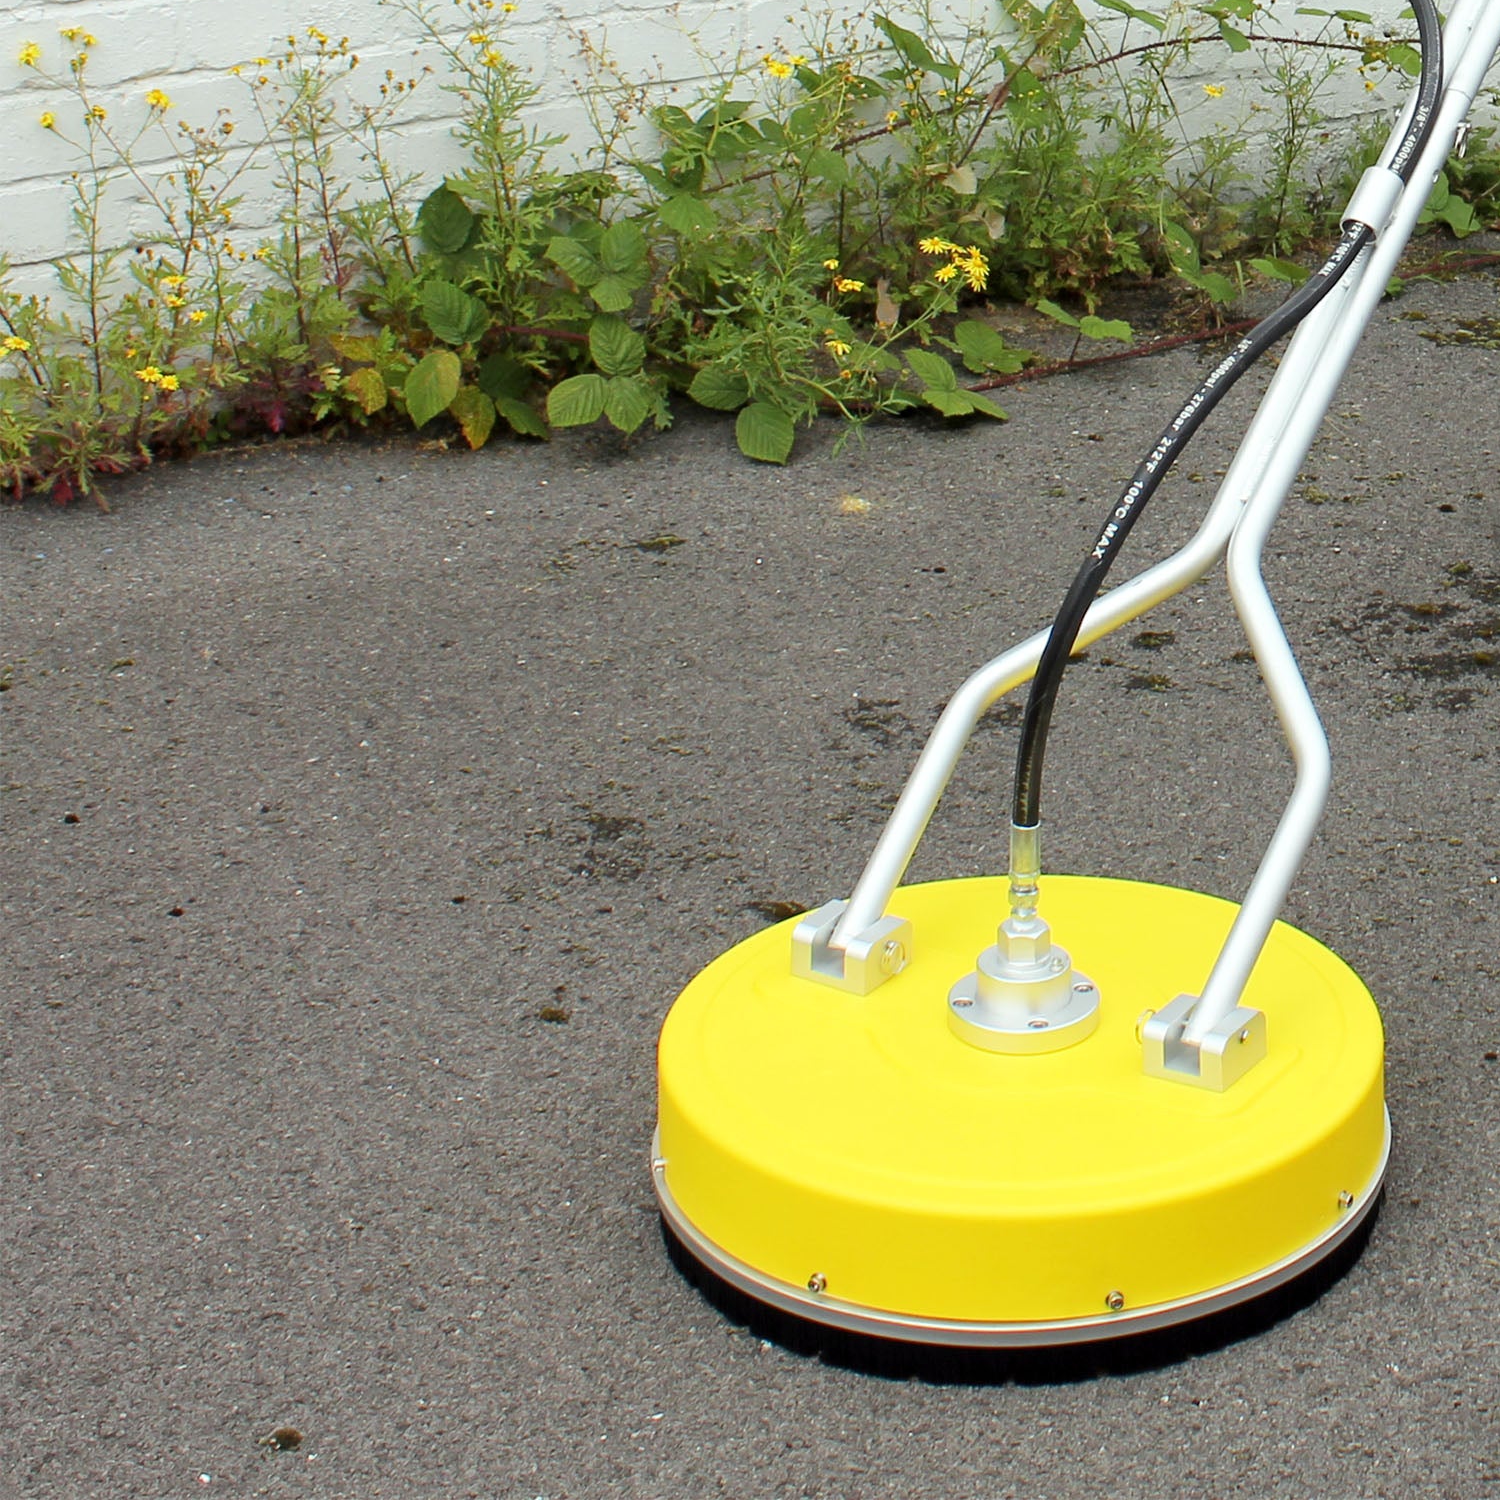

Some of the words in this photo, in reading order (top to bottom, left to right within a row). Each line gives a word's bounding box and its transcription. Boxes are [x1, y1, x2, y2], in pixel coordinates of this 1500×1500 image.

[1171, 393, 1204, 431] 276bar
[1146, 436, 1172, 474] 212°F
[1115, 481, 1144, 519] 100°C
[1091, 522, 1119, 559] MAX
